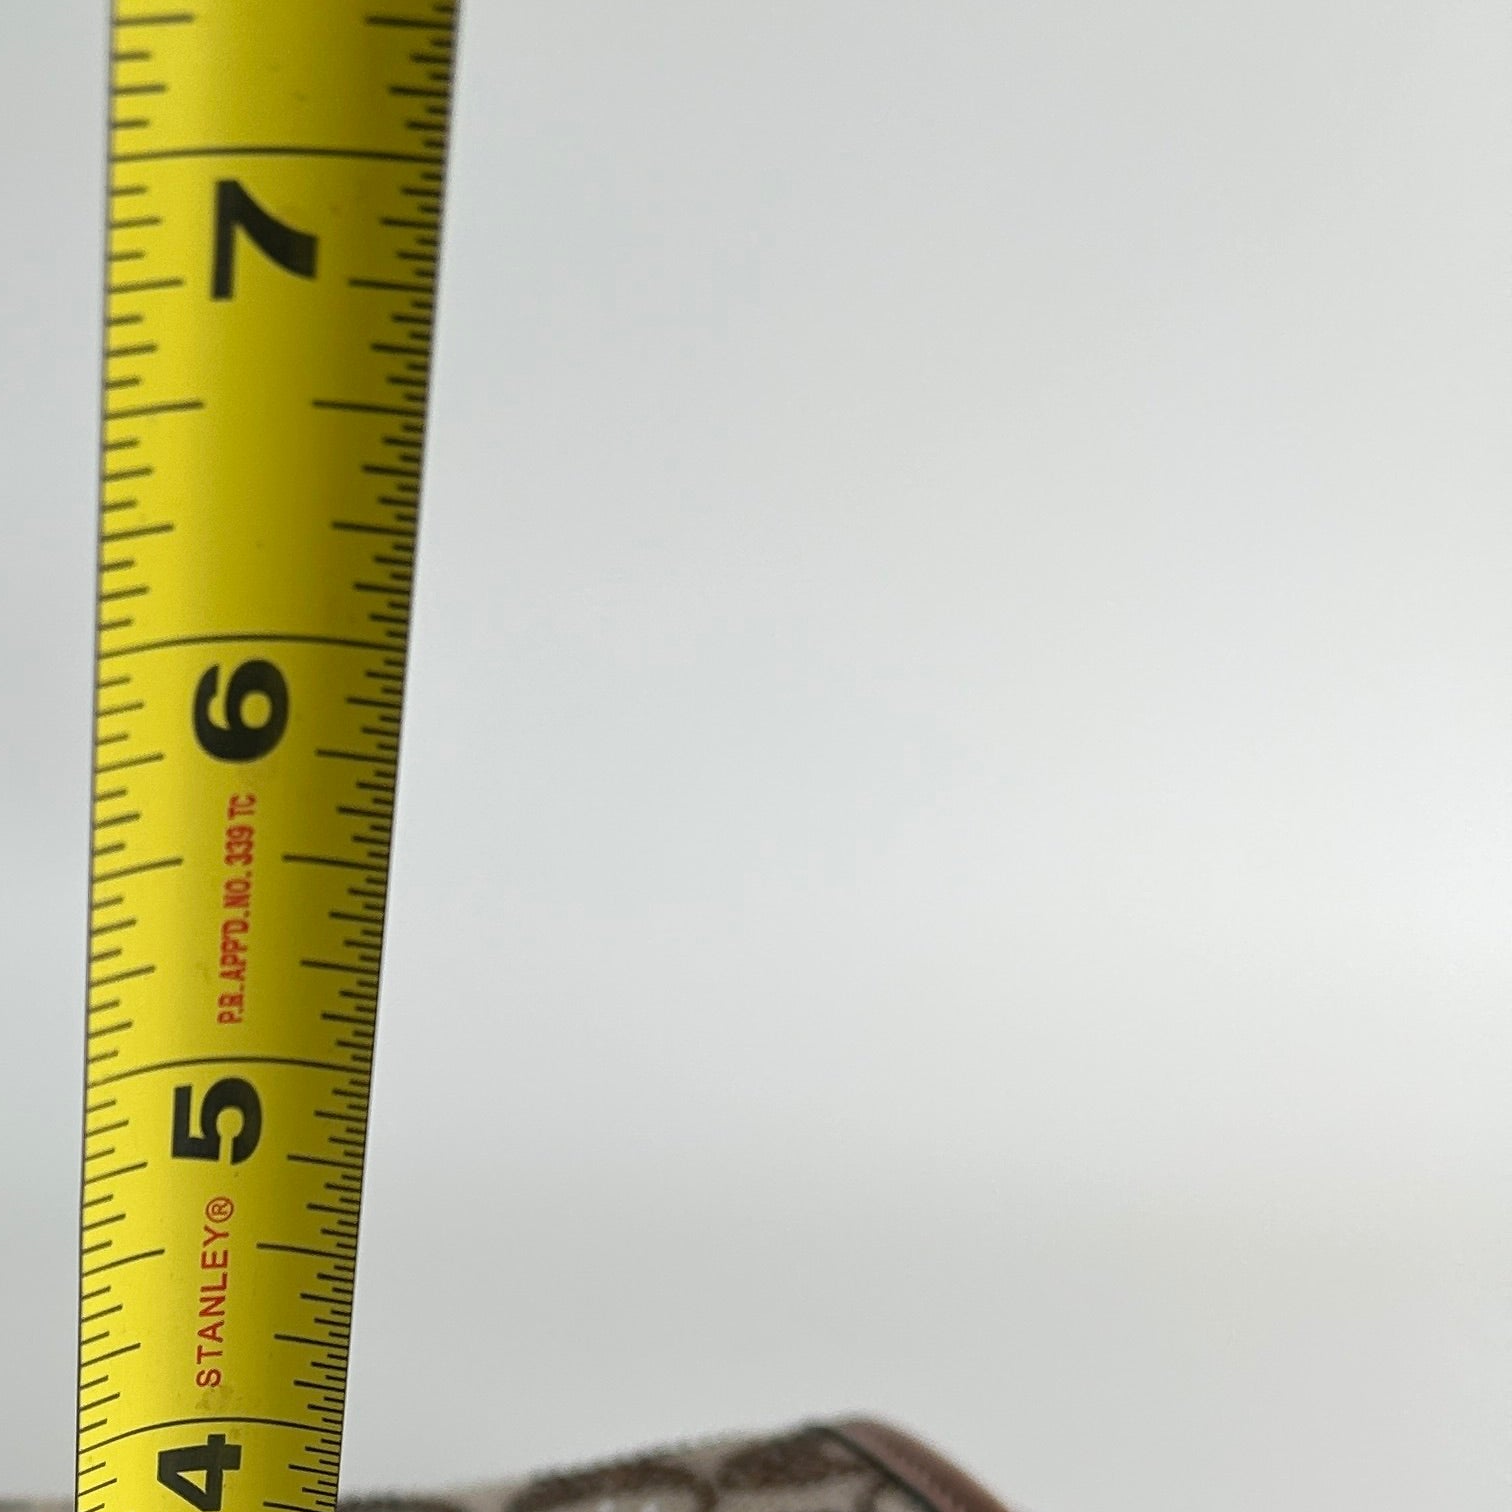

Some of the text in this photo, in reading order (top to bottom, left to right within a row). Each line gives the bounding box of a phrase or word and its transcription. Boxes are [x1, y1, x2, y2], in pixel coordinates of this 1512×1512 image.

[210, 180, 318, 300] 7
[193, 659, 290, 763] 6
[224, 825, 255, 866] 339
[228, 792, 257, 820] TC
[171, 1077, 262, 1166] 5
[157, 1433, 242, 1512] 4
